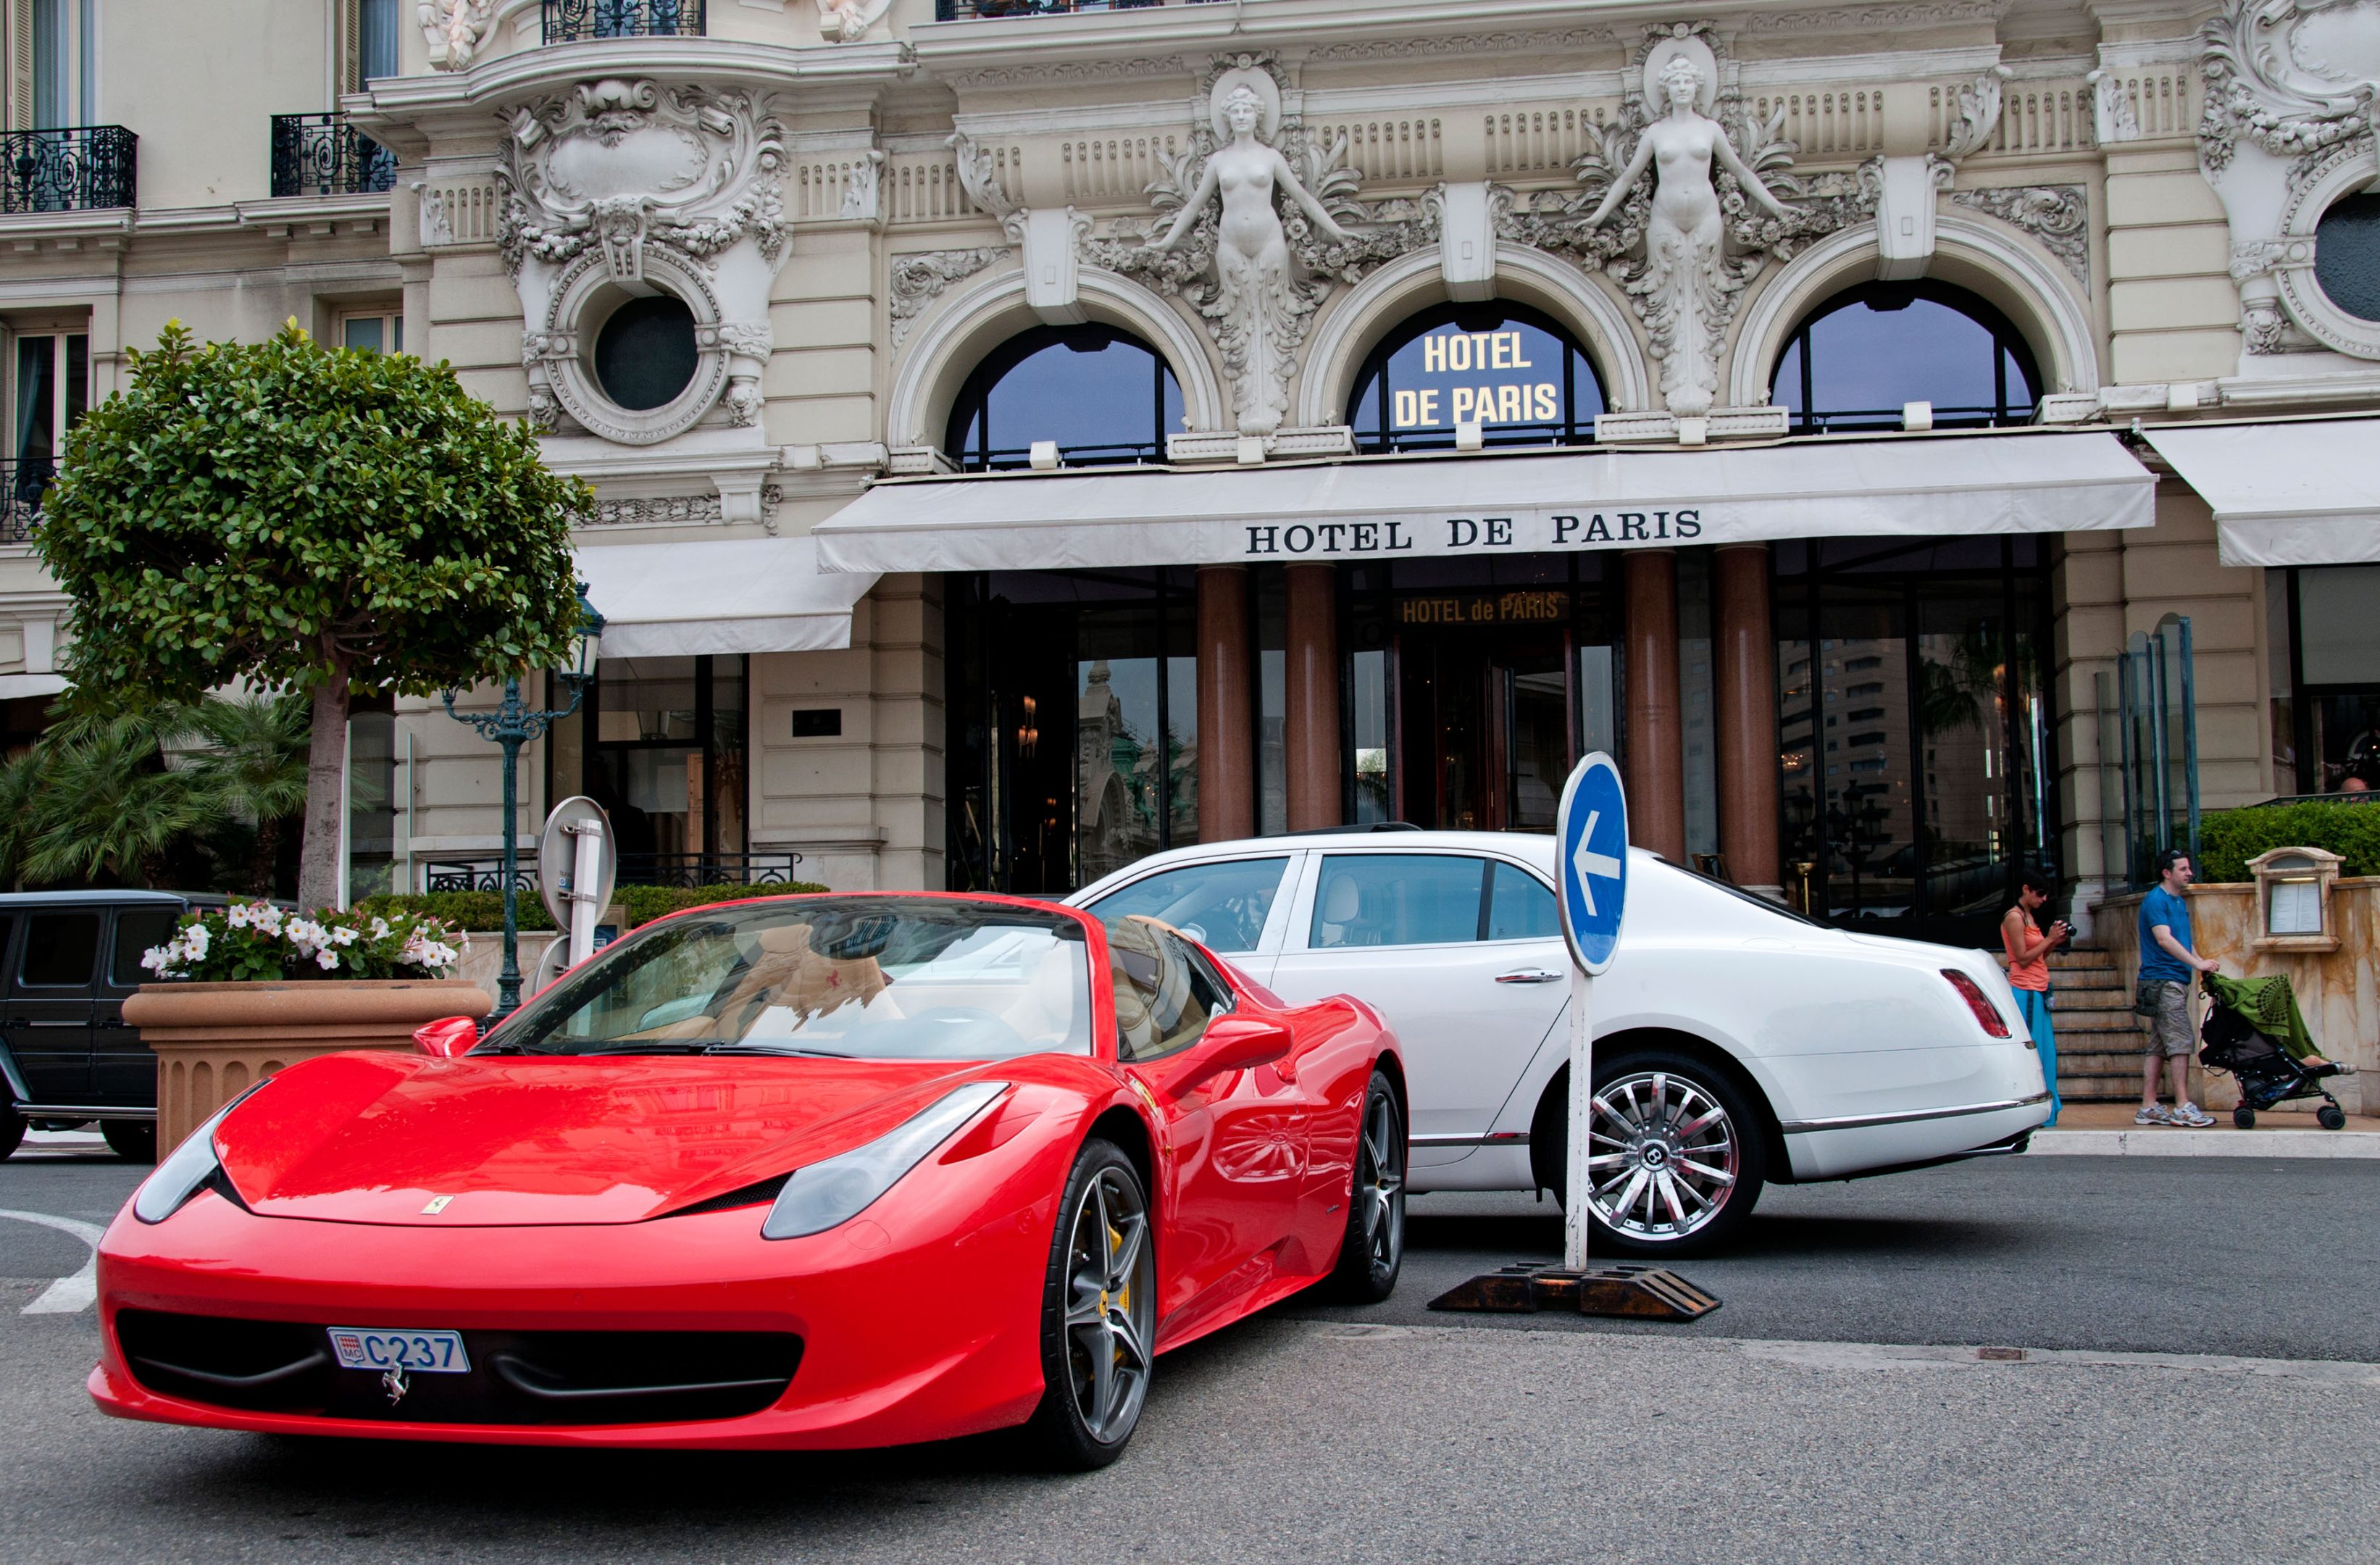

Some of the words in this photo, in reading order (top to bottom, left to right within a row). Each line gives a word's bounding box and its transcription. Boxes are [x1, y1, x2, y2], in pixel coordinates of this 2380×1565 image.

[1424, 332, 1532, 372] HOTEL
[1395, 389, 1440, 427] DE
[1453, 383, 1557, 424] PARIS
[1245, 522, 1412, 554] HOTEL
[1447, 517, 1513, 547] DE
[1551, 509, 1701, 544] PARIS
[1403, 600, 1466, 623] HOTEL
[1471, 598, 1494, 621] de
[1500, 596, 1558, 619] PARIS
[343, 1348, 362, 1358] MC
[365, 1335, 454, 1367] C237
